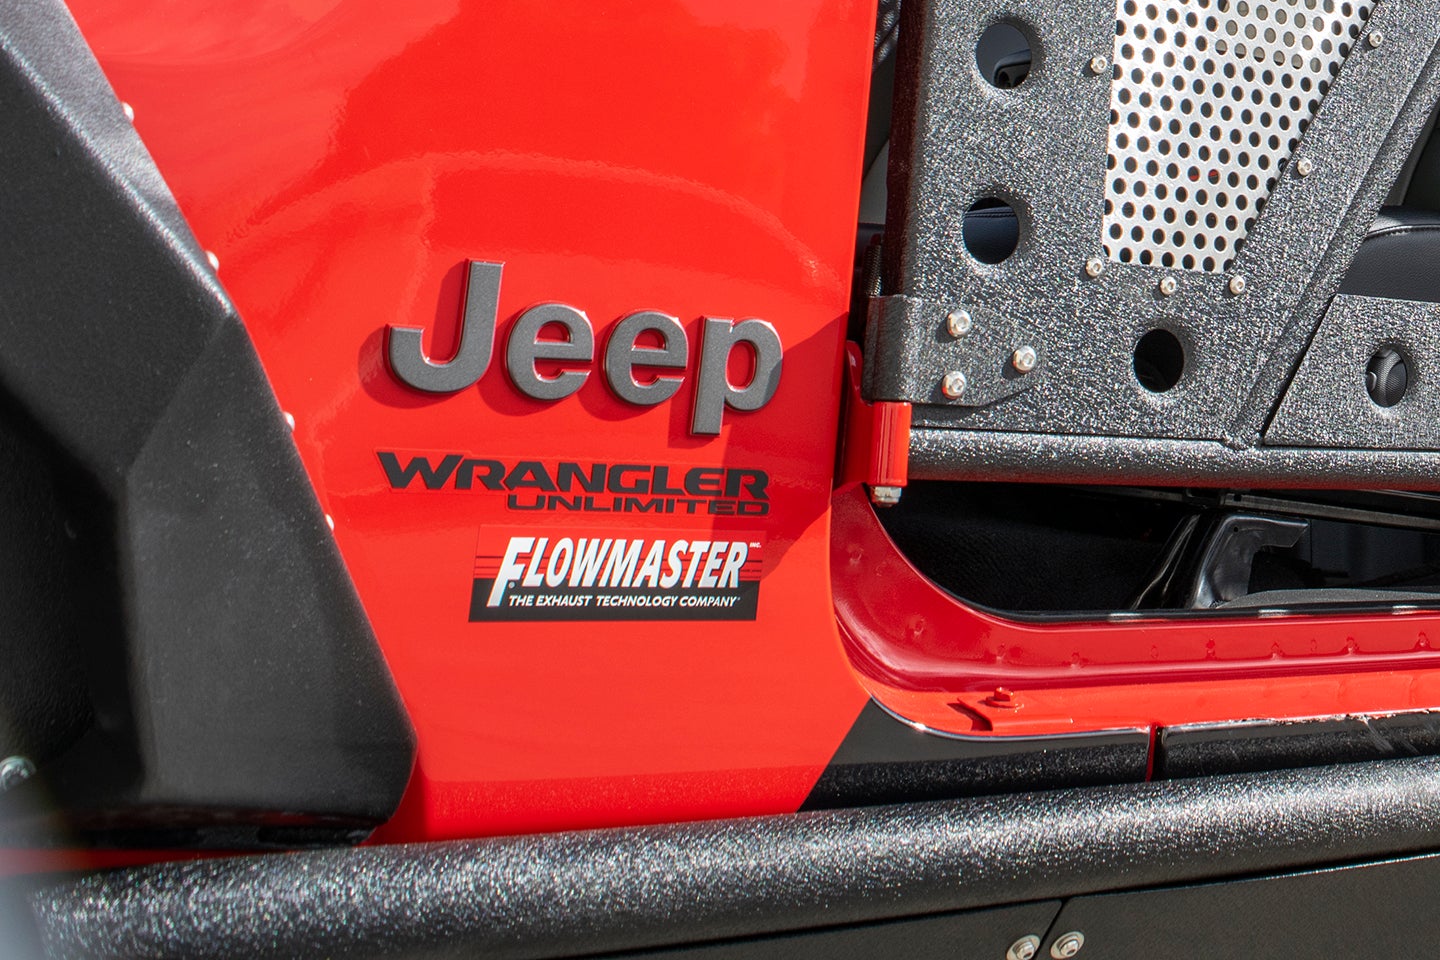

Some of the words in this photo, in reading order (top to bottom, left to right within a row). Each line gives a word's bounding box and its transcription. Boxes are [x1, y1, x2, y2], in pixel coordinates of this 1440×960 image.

[386, 259, 783, 436] Jeep
[377, 451, 770, 499] WRANGLER
[507, 494, 770, 516] UNLIMITED
[487, 536, 749, 607] FLOWMASTER
[508, 594, 535, 607] THE
[535, 594, 593, 607] EXHAUST
[596, 594, 679, 607] TECHNOLOGY
[679, 595, 737, 608] COMPANY
